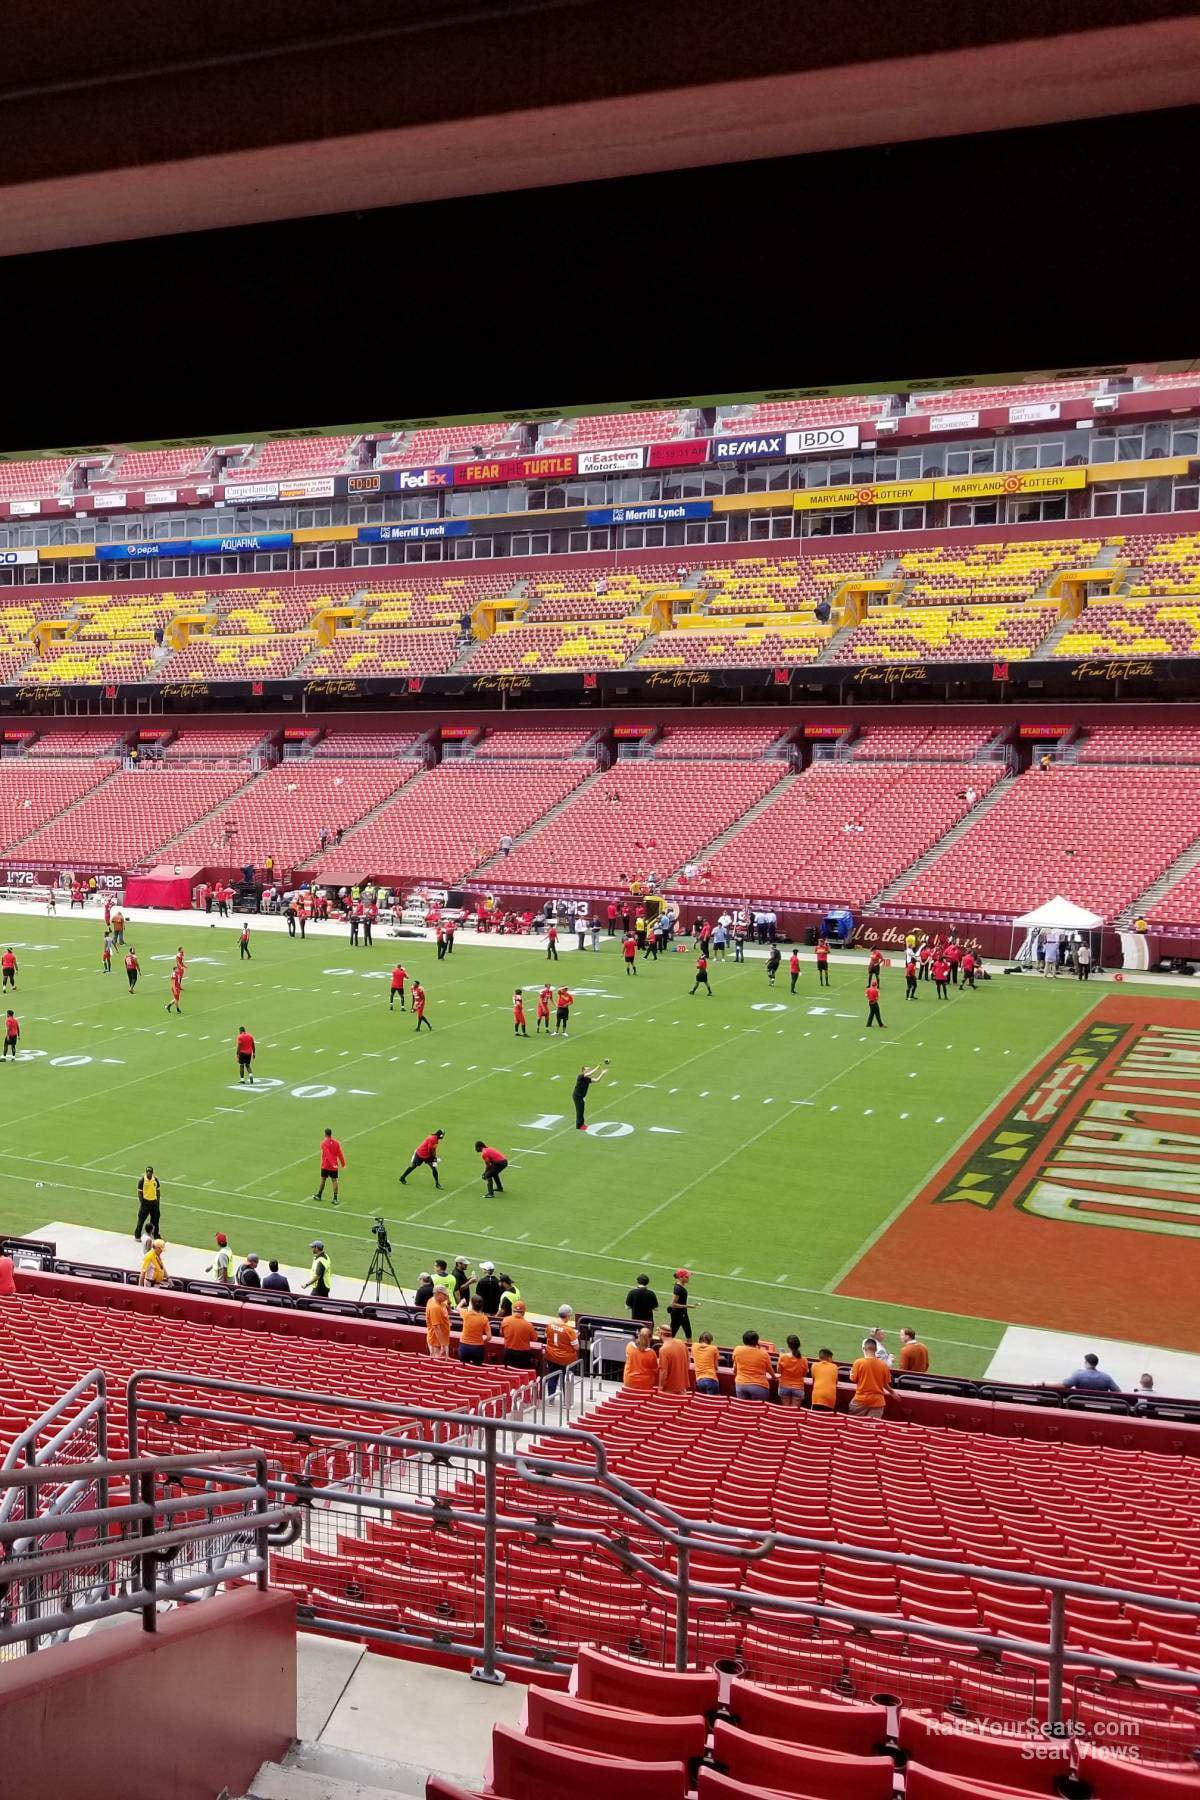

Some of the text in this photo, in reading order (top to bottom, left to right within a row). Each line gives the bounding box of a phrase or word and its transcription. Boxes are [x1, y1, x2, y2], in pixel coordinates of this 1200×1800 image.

[804, 430, 845, 446] BDO
[717, 439, 780, 457] RE/MAX
[592, 452, 639, 464] Eastern
[400, 469, 447, 489] FedEx
[952, 482, 1001, 494] MARYLAND
[1023, 477, 1065, 488] LOTTERY
[810, 493, 855, 504] MARYLAND
[875, 489, 914, 499] LOTTERY
[625, 506, 686, 521] Merrill Lynch
[391, 525, 445, 538] Merrill Lynch
[136, 545, 159, 555] pepsi
[220, 537, 259, 550] AQUAFINA
[551, 899, 588, 916] 13
[1114, 973, 1124, 982] G
[228, 1077, 338, 1099] 20
[518, 1113, 635, 1138] 10
